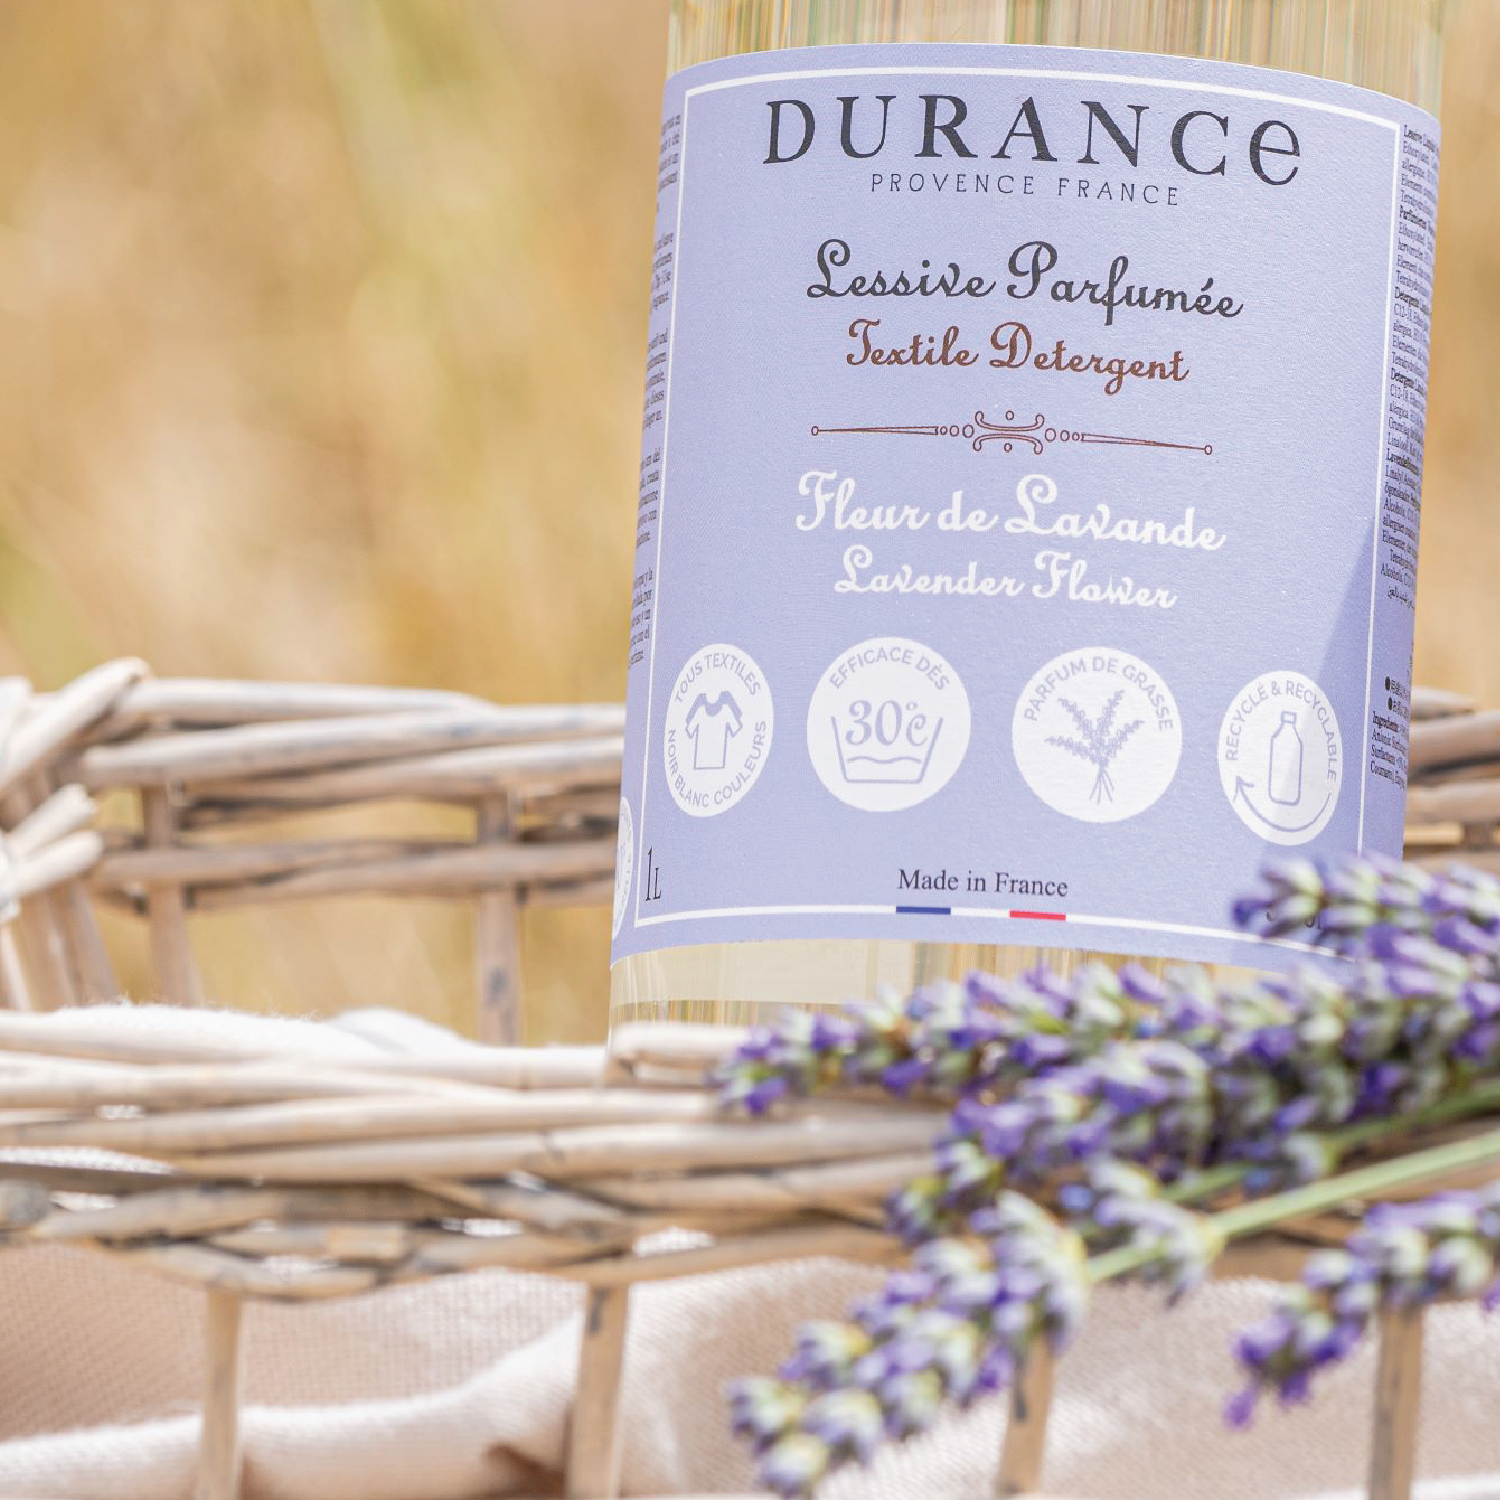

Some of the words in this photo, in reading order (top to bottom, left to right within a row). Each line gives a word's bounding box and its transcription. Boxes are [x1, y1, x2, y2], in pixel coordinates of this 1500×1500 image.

[872, 174, 1033, 194] PROVENCE
[1059, 178, 1177, 205] FRANCE
[807, 239, 996, 298] Lessive
[1006, 241, 1243, 326] Parfumée
[847, 319, 979, 366] Textile
[989, 320, 1189, 396] Detergent
[796, 470, 930, 531] Fleur
[938, 490, 999, 531] de
[1004, 474, 1226, 552] Lavande
[835, 545, 1025, 596] Lavender
[1032, 551, 1177, 608] Flower
[675, 661, 703, 704] TOUS
[704, 652, 761, 696] TEXTILES
[828, 646, 914, 690] EFFICACE
[1023, 657, 1086, 722] PARFUM
[1092, 656, 1119, 674] DE
[1121, 663, 1174, 732] GRASSE
[668, 729, 679, 777] NOIR
[674, 776, 710, 808] BLANC
[713, 720, 767, 806] COULEURS
[1225, 674, 1269, 762] RECYCLÉ
[1271, 679, 1281, 695] &
[1285, 679, 1337, 781] RECYCLABLE
[900, 869, 958, 890] Made
[968, 871, 986, 891] in
[996, 872, 1067, 897] France
